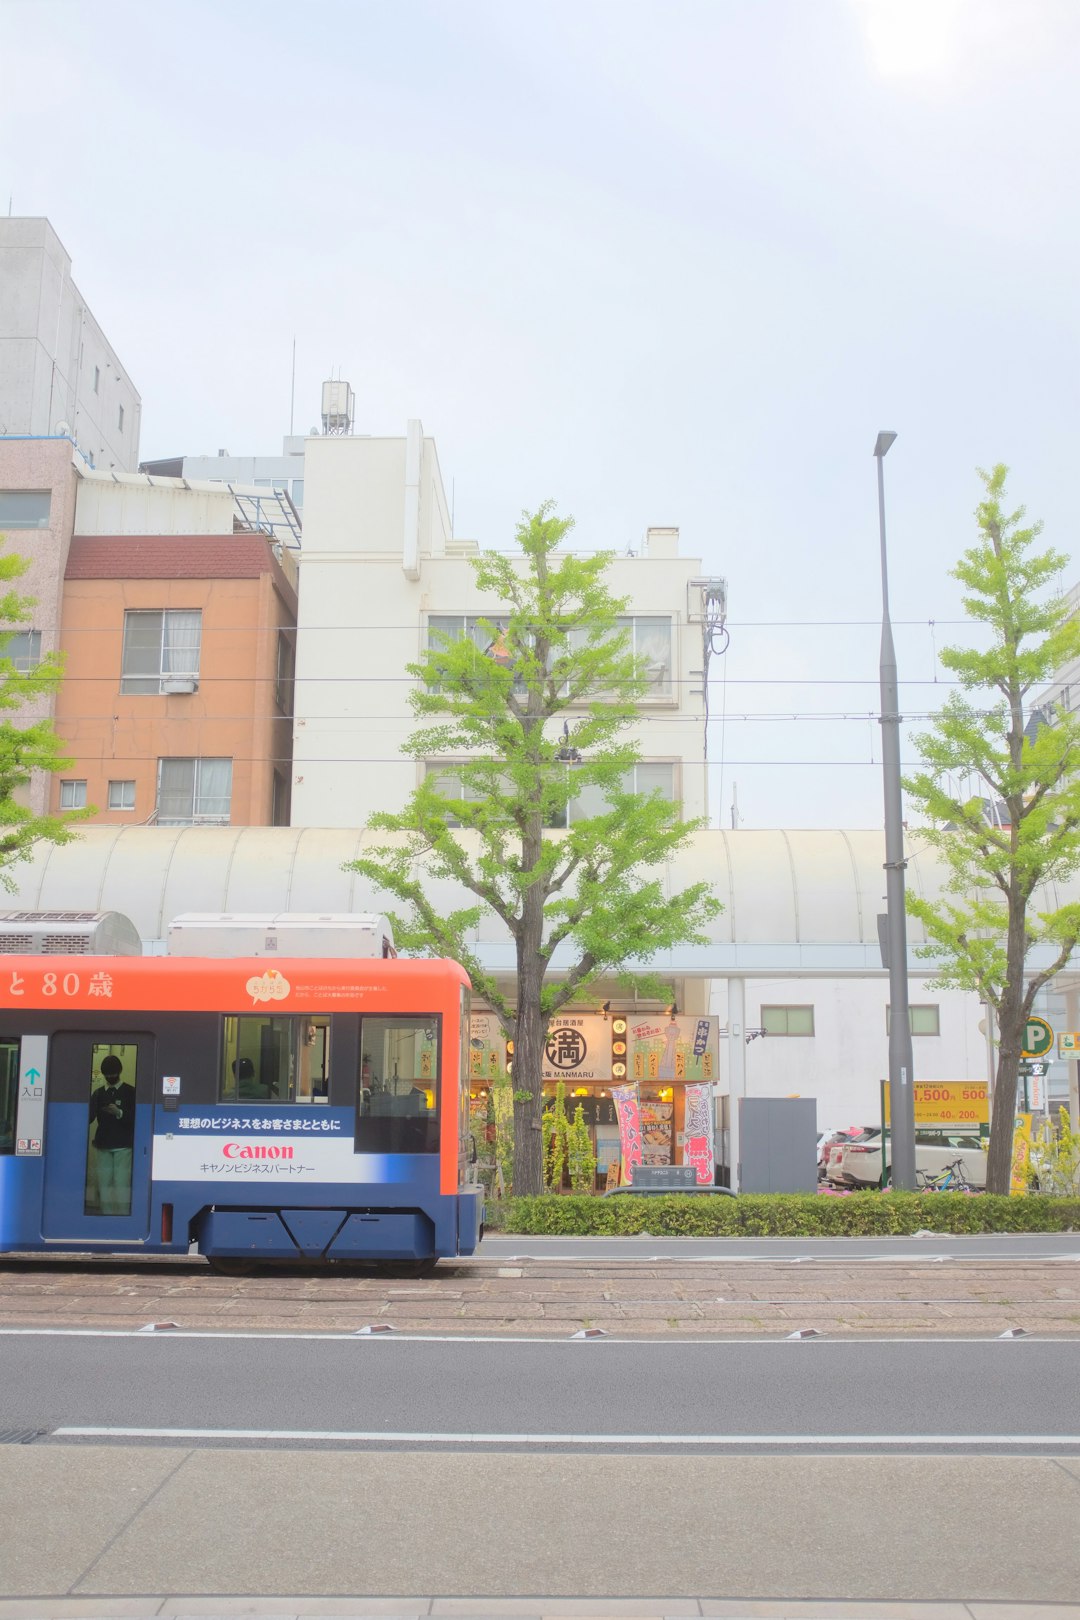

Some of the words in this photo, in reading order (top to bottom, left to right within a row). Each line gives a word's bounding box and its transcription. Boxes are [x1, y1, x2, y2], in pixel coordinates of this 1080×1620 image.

[695, 1026, 708, 1053] 串かつ
[1026, 1025, 1046, 1051] P
[548, 1031, 580, 1064] 満
[21, 1087, 43, 1097] 入口
[178, 1117, 342, 1131] 理想のビジネスをお客さまとともに
[222, 1143, 294, 1159] Canon
[199, 1163, 316, 1175] キヤノンビジネスパートナー
